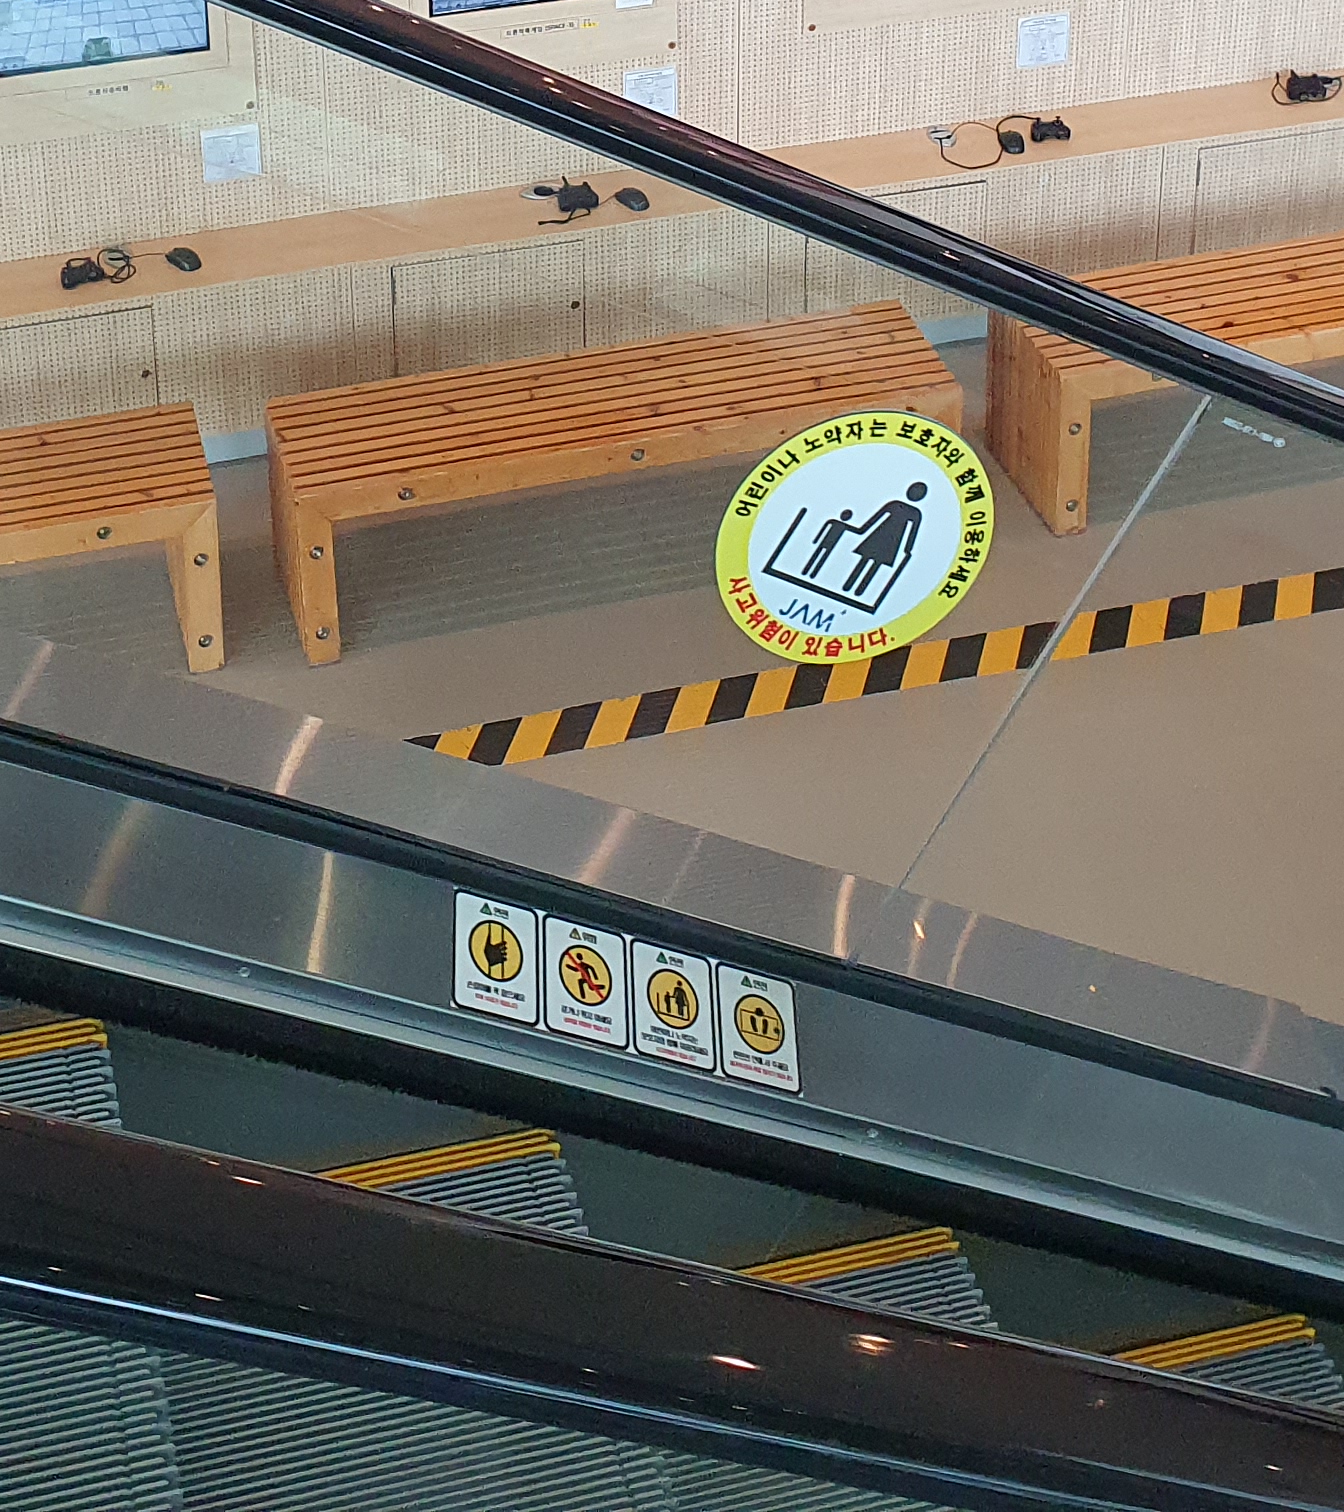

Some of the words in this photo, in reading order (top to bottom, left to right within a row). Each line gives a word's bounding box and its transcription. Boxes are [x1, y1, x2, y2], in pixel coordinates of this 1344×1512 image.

[804, 418, 888, 454] 노약자는
[896, 420, 966, 468] 보호자와
[735, 450, 801, 518] 어린이나
[955, 467, 987, 504] 함께
[938, 510, 987, 599] 이용하세요
[729, 576, 801, 652] 사고위험이
[801, 627, 896, 658] 있습니다.
[778, 598, 836, 633] JAM
